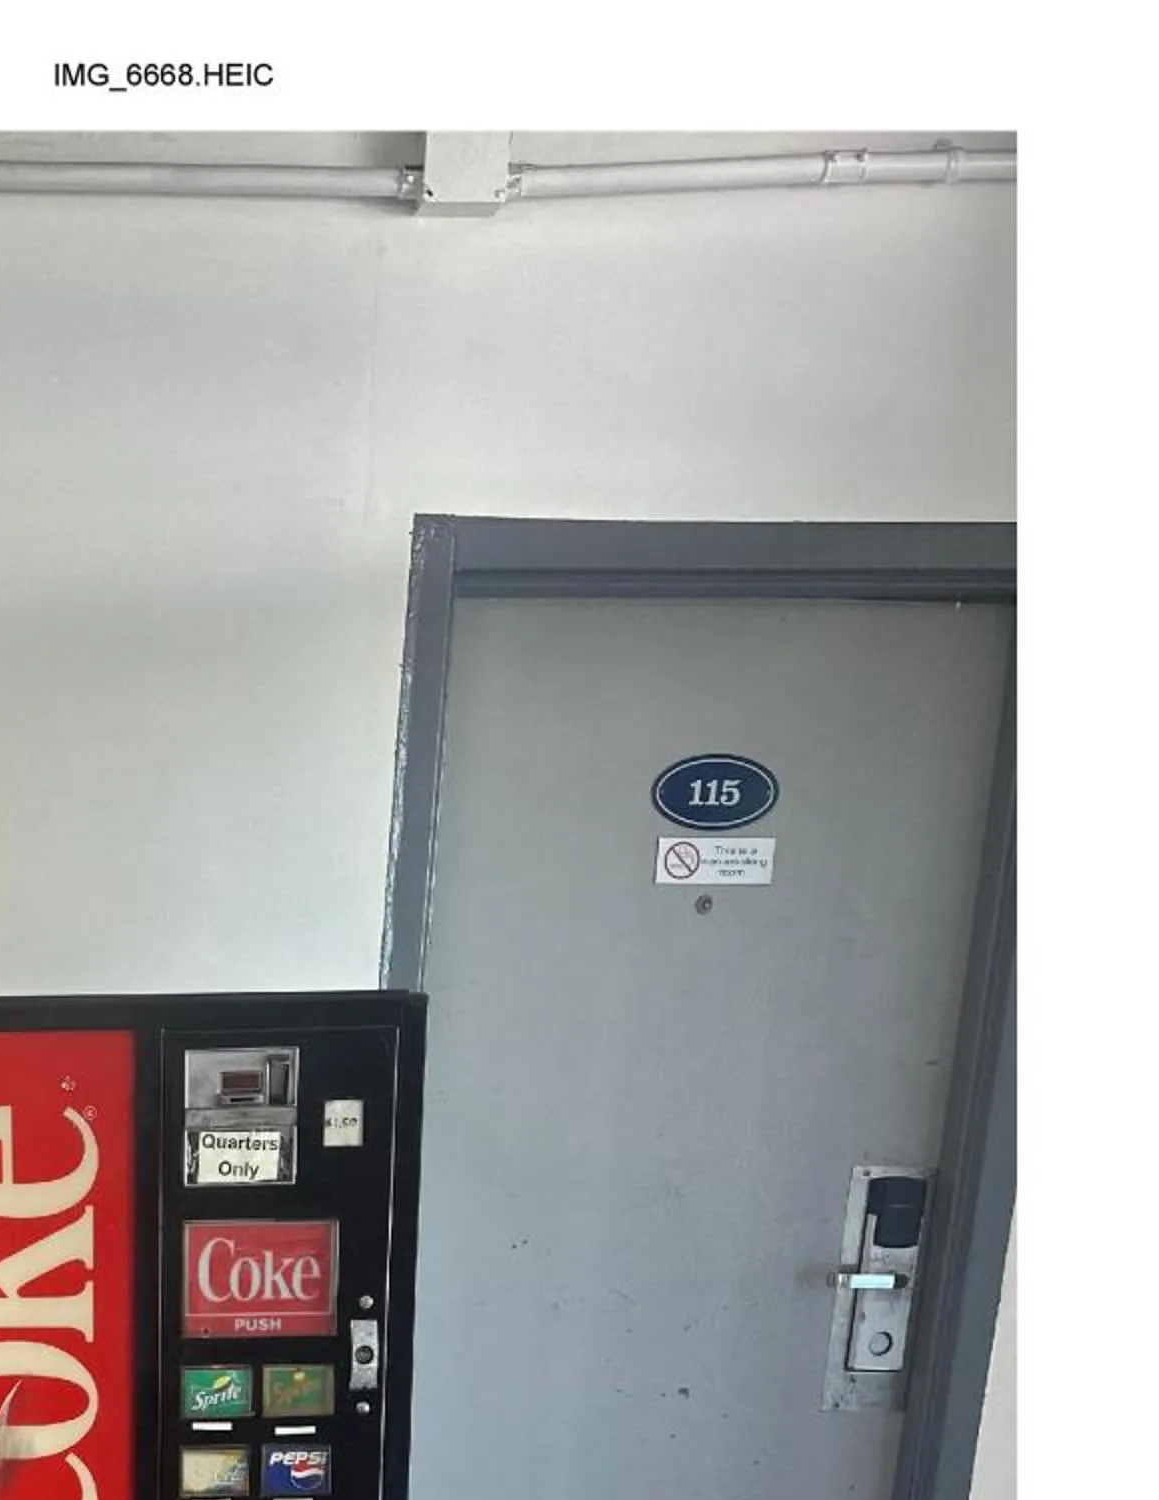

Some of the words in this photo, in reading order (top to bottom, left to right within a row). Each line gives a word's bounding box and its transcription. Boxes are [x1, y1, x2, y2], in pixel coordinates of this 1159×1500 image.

[689, 779, 741, 806] 115
[202, 1133, 278, 1151] Quarters
[218, 1161, 259, 1179] Only
[197, 1237, 322, 1302] Coke
[234, 1317, 282, 1332] PUSH
[191, 1382, 242, 1412] Sprite
[269, 1451, 328, 1466] PEPSI
